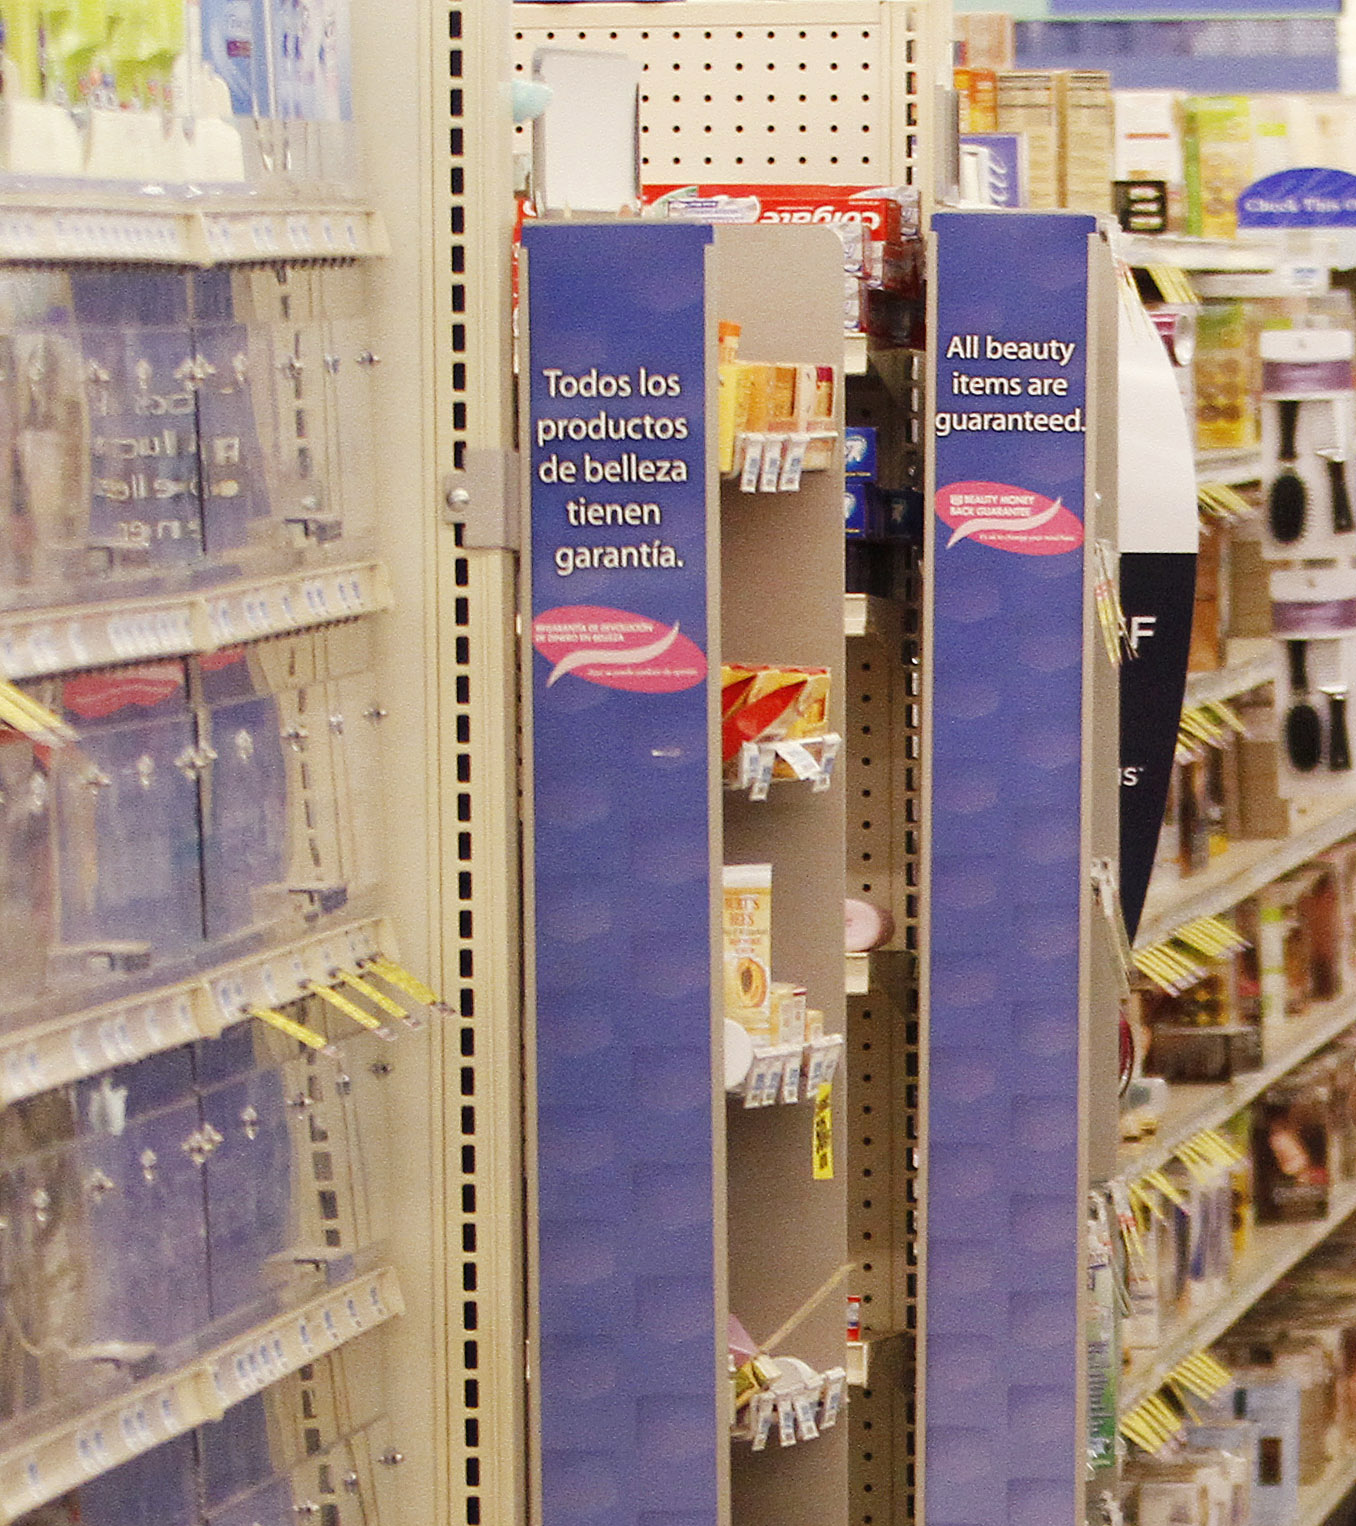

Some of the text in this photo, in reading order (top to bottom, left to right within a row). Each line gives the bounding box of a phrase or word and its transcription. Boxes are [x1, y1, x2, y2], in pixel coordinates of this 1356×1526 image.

[1244, 197, 1299, 214] Check
[1303, 196, 1344, 213] This
[946, 335, 1075, 366] All beauty
[543, 367, 681, 397] Todos los
[952, 372, 1068, 396] items are
[537, 411, 688, 447] productos
[935, 408, 1086, 437] guaranteed.
[539, 453, 687, 483] de belleza
[566, 497, 661, 526] tienen
[965, 495, 997, 504] BEAUTY
[555, 541, 684, 576] garantía.
